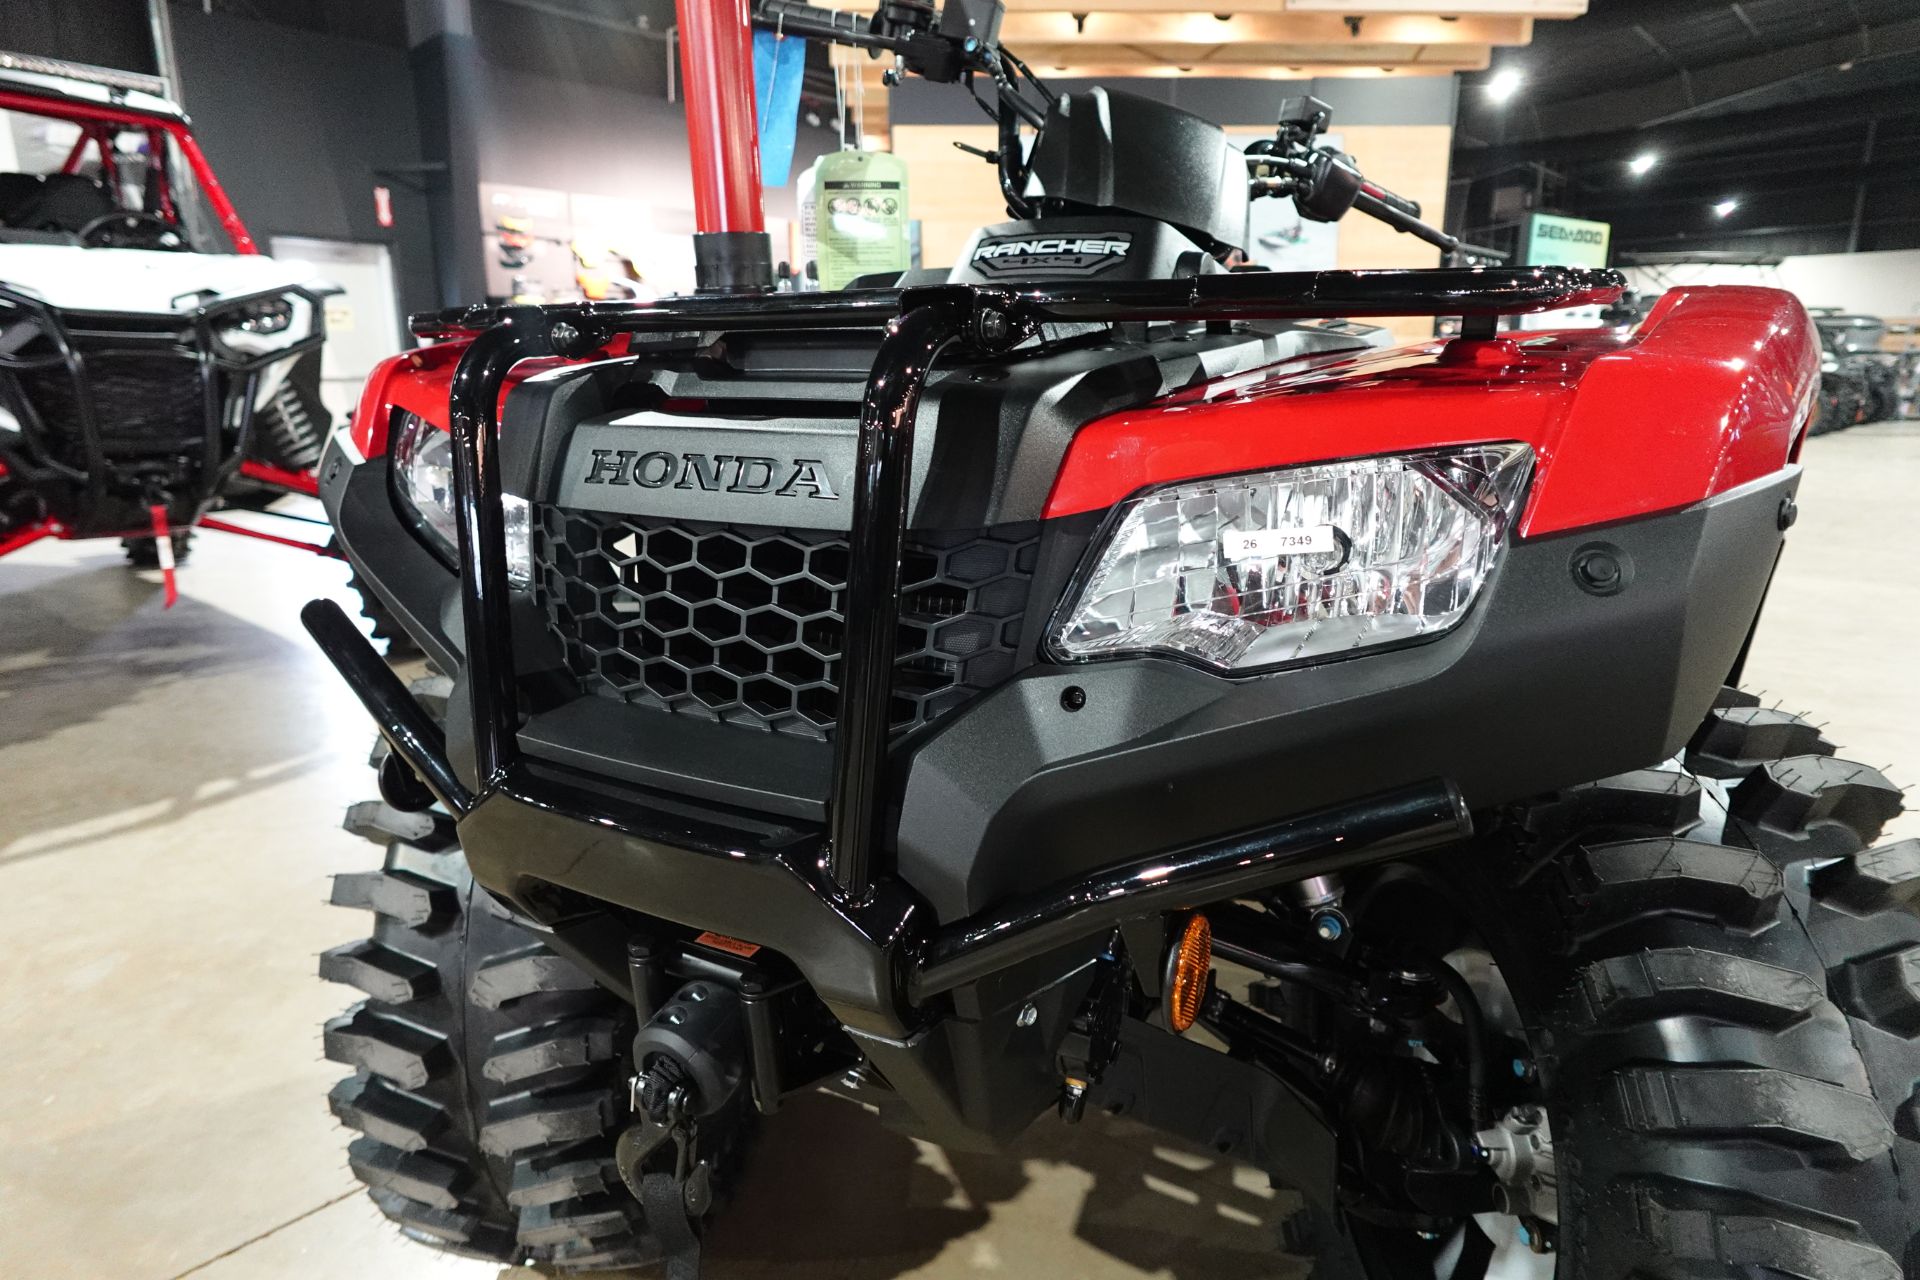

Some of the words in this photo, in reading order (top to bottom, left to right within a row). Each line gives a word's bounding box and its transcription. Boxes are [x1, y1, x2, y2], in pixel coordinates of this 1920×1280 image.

[973, 239, 1131, 261] RANCHER
[584, 449, 839, 500] HONDA
[1242, 539, 1258, 550] 26
[1280, 535, 1313, 547] 7349
